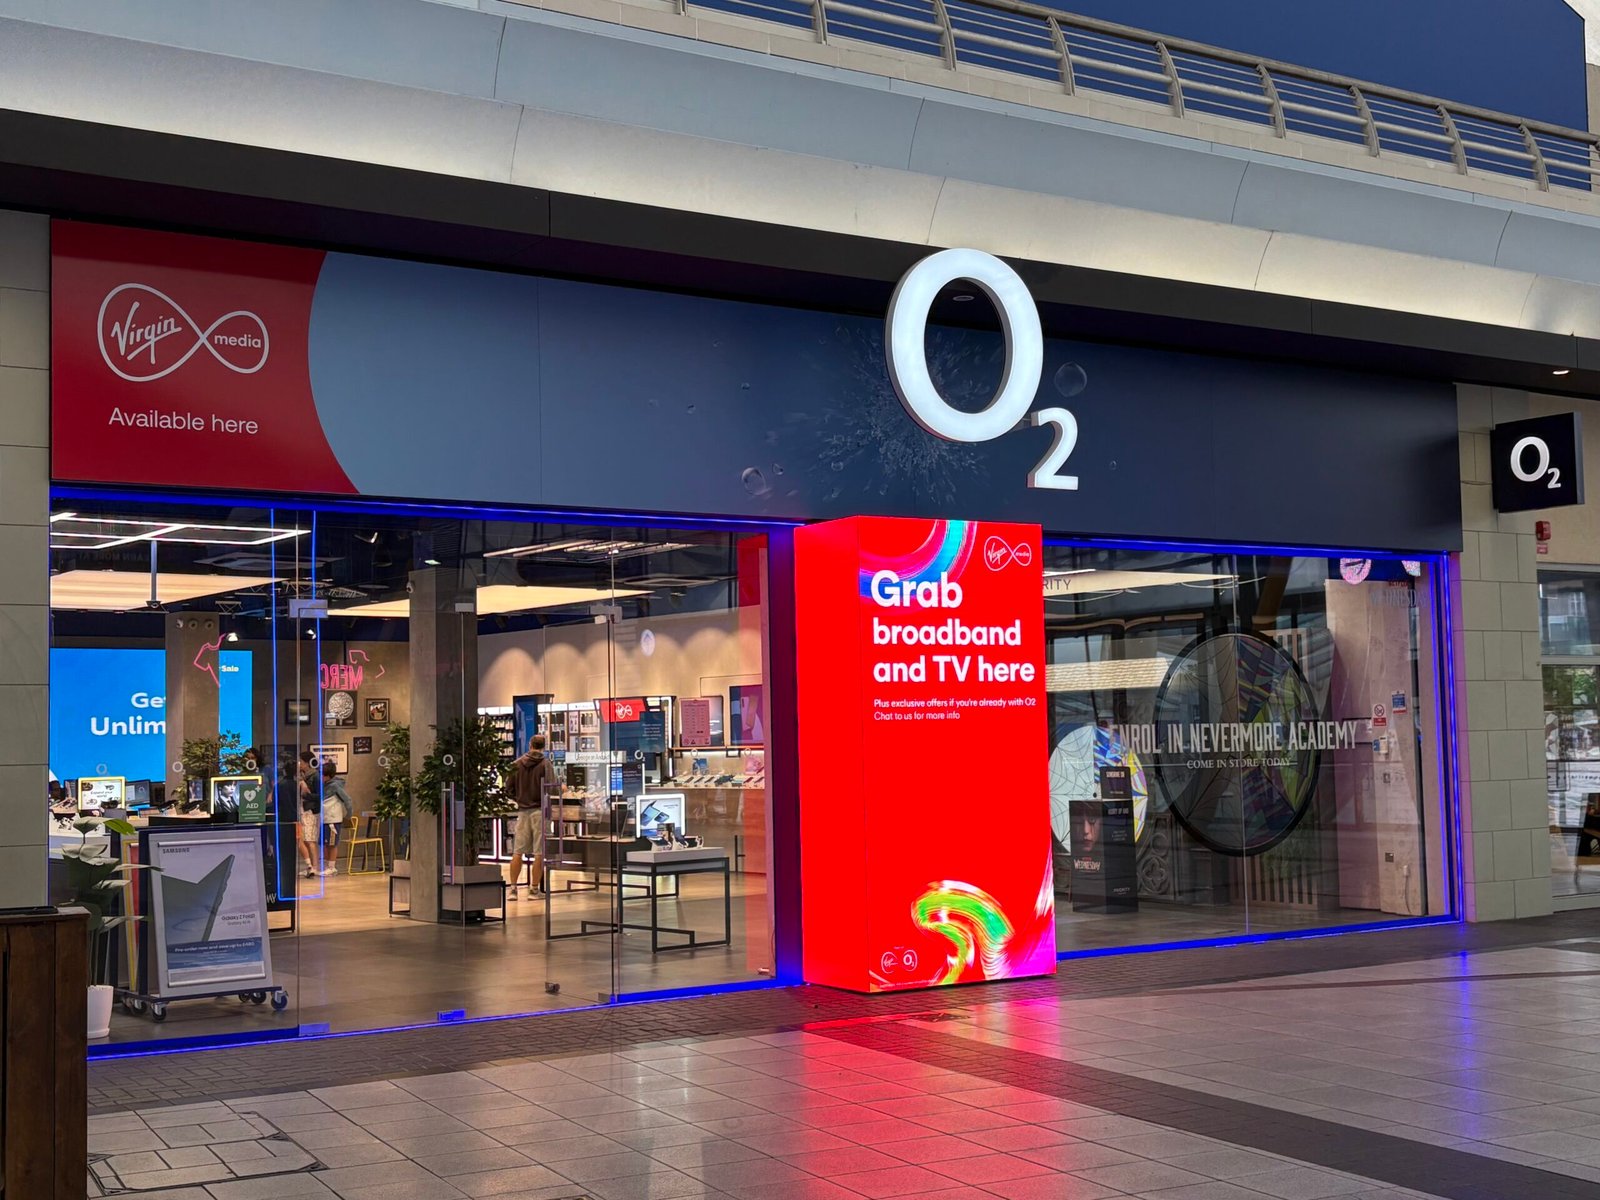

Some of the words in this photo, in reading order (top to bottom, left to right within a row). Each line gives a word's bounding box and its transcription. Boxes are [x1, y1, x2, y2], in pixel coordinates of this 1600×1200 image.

[110, 301, 182, 364] Virgin
[214, 334, 262, 349] media
[885, 248, 1079, 491] O2
[108, 407, 205, 431] Available
[211, 414, 259, 435] here
[1510, 436, 1562, 489] O2
[986, 541, 1008, 565] Virgin
[871, 569, 963, 608] Grab
[873, 617, 1021, 646] broadband
[873, 655, 926, 682] and
[932, 655, 971, 682] TV
[978, 655, 1035, 682] here
[873, 699, 890, 708] Plus
[891, 698, 925, 708] exclusive
[926, 698, 948, 707] offers
[949, 698, 954, 707] if
[955, 698, 978, 709] you're
[979, 698, 1007, 709] already
[1008, 697, 1024, 706] with
[1025, 697, 1037, 706] O2
[873, 711, 893, 720] Chat
[894, 711, 903, 720] to
[904, 712, 913, 720] us
[914, 711, 925, 720] for
[925, 712, 945, 720] more
[946, 711, 960, 719] info
[90, 716, 166, 736] Unlim
[1108, 723, 1162, 754] ENROL
[1167, 723, 1184, 753] IN
[1189, 722, 1282, 753] NEVERMORE
[1288, 721, 1358, 750] ACADEMY
[1186, 759, 1215, 769] COME
[1216, 759, 1227, 768] IN
[1228, 758, 1259, 768] STORE
[1261, 757, 1292, 767] TODAY
